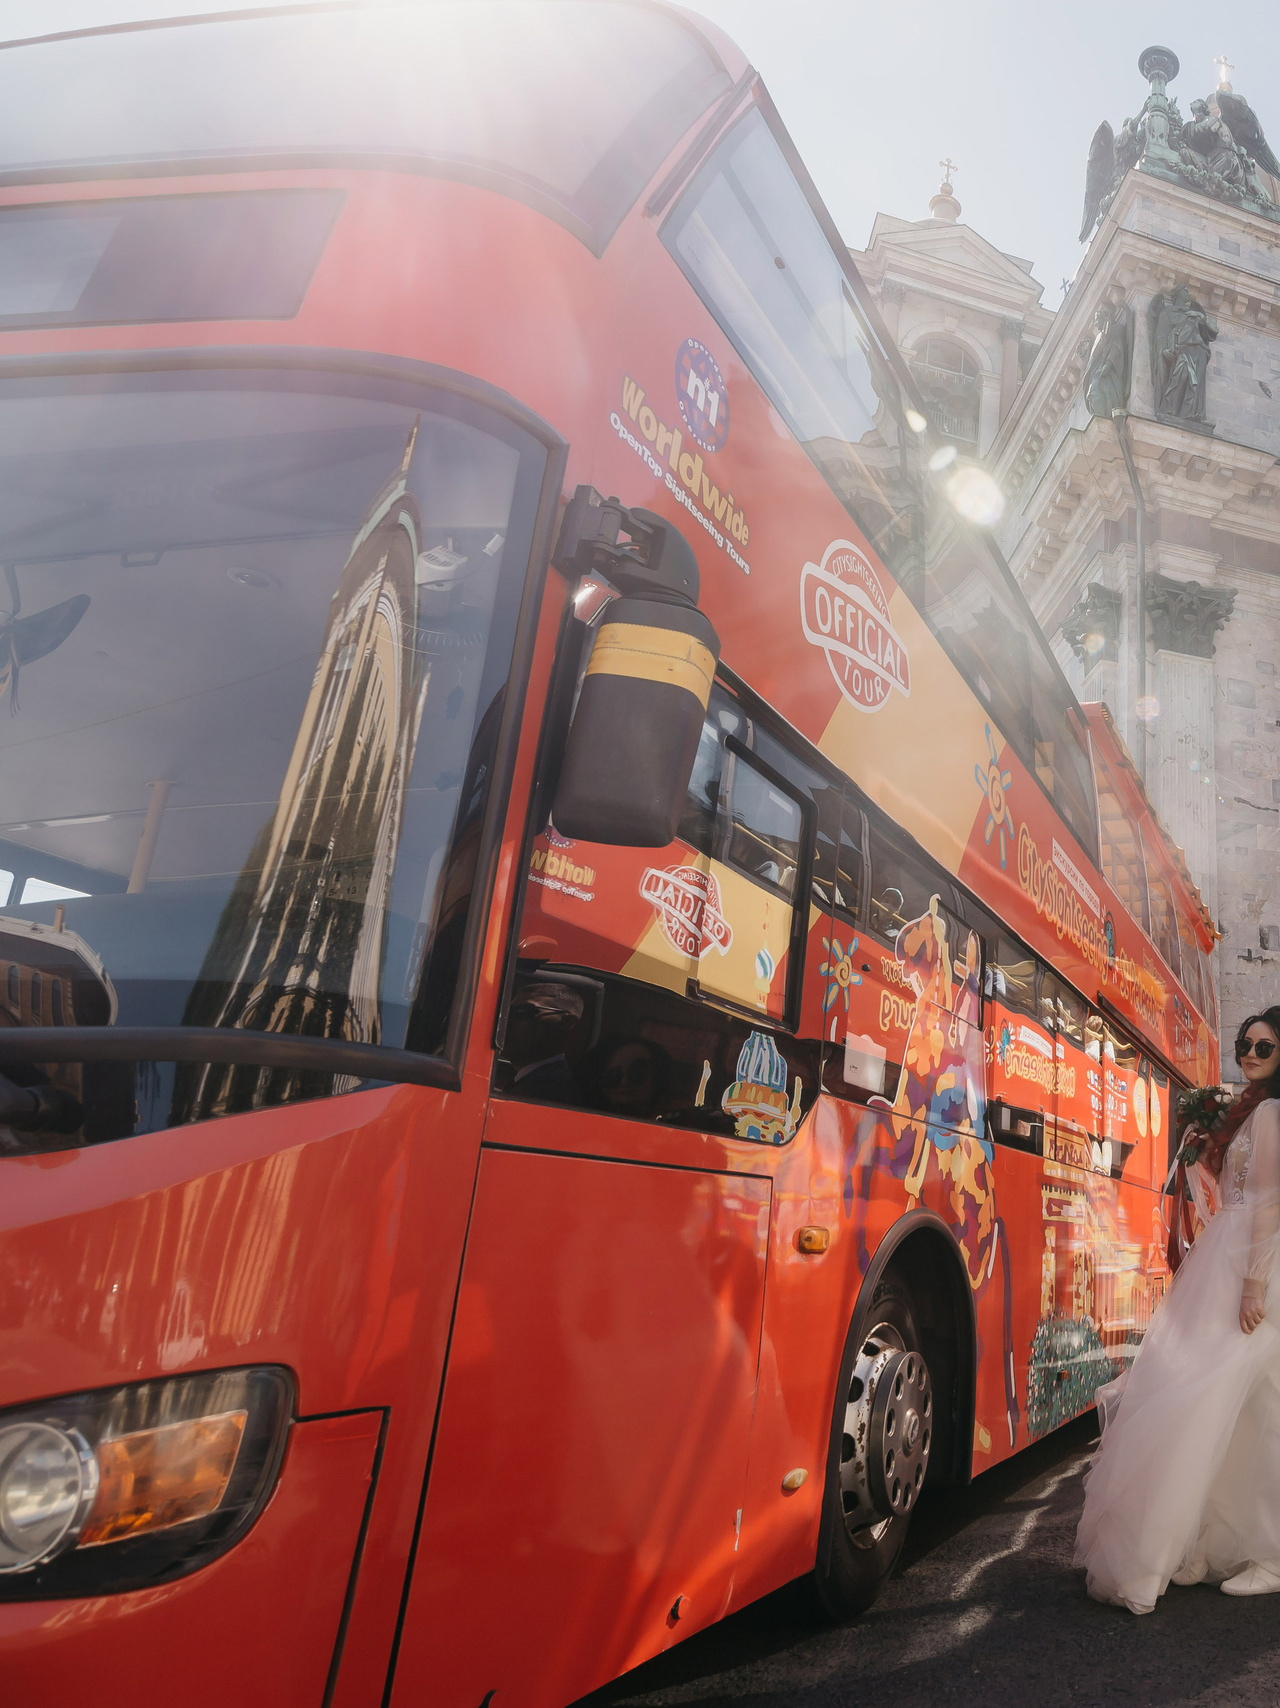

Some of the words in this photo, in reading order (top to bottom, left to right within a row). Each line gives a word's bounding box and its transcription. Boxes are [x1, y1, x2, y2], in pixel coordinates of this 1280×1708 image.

[610, 412, 663, 478] OpenTop
[665, 473, 724, 548] Sightseeing
[725, 538, 751, 575] Tours
[622, 375, 749, 547] Worldwide
[815, 586, 905, 685] OFFICIAL
[844, 656, 885, 703] TOUR
